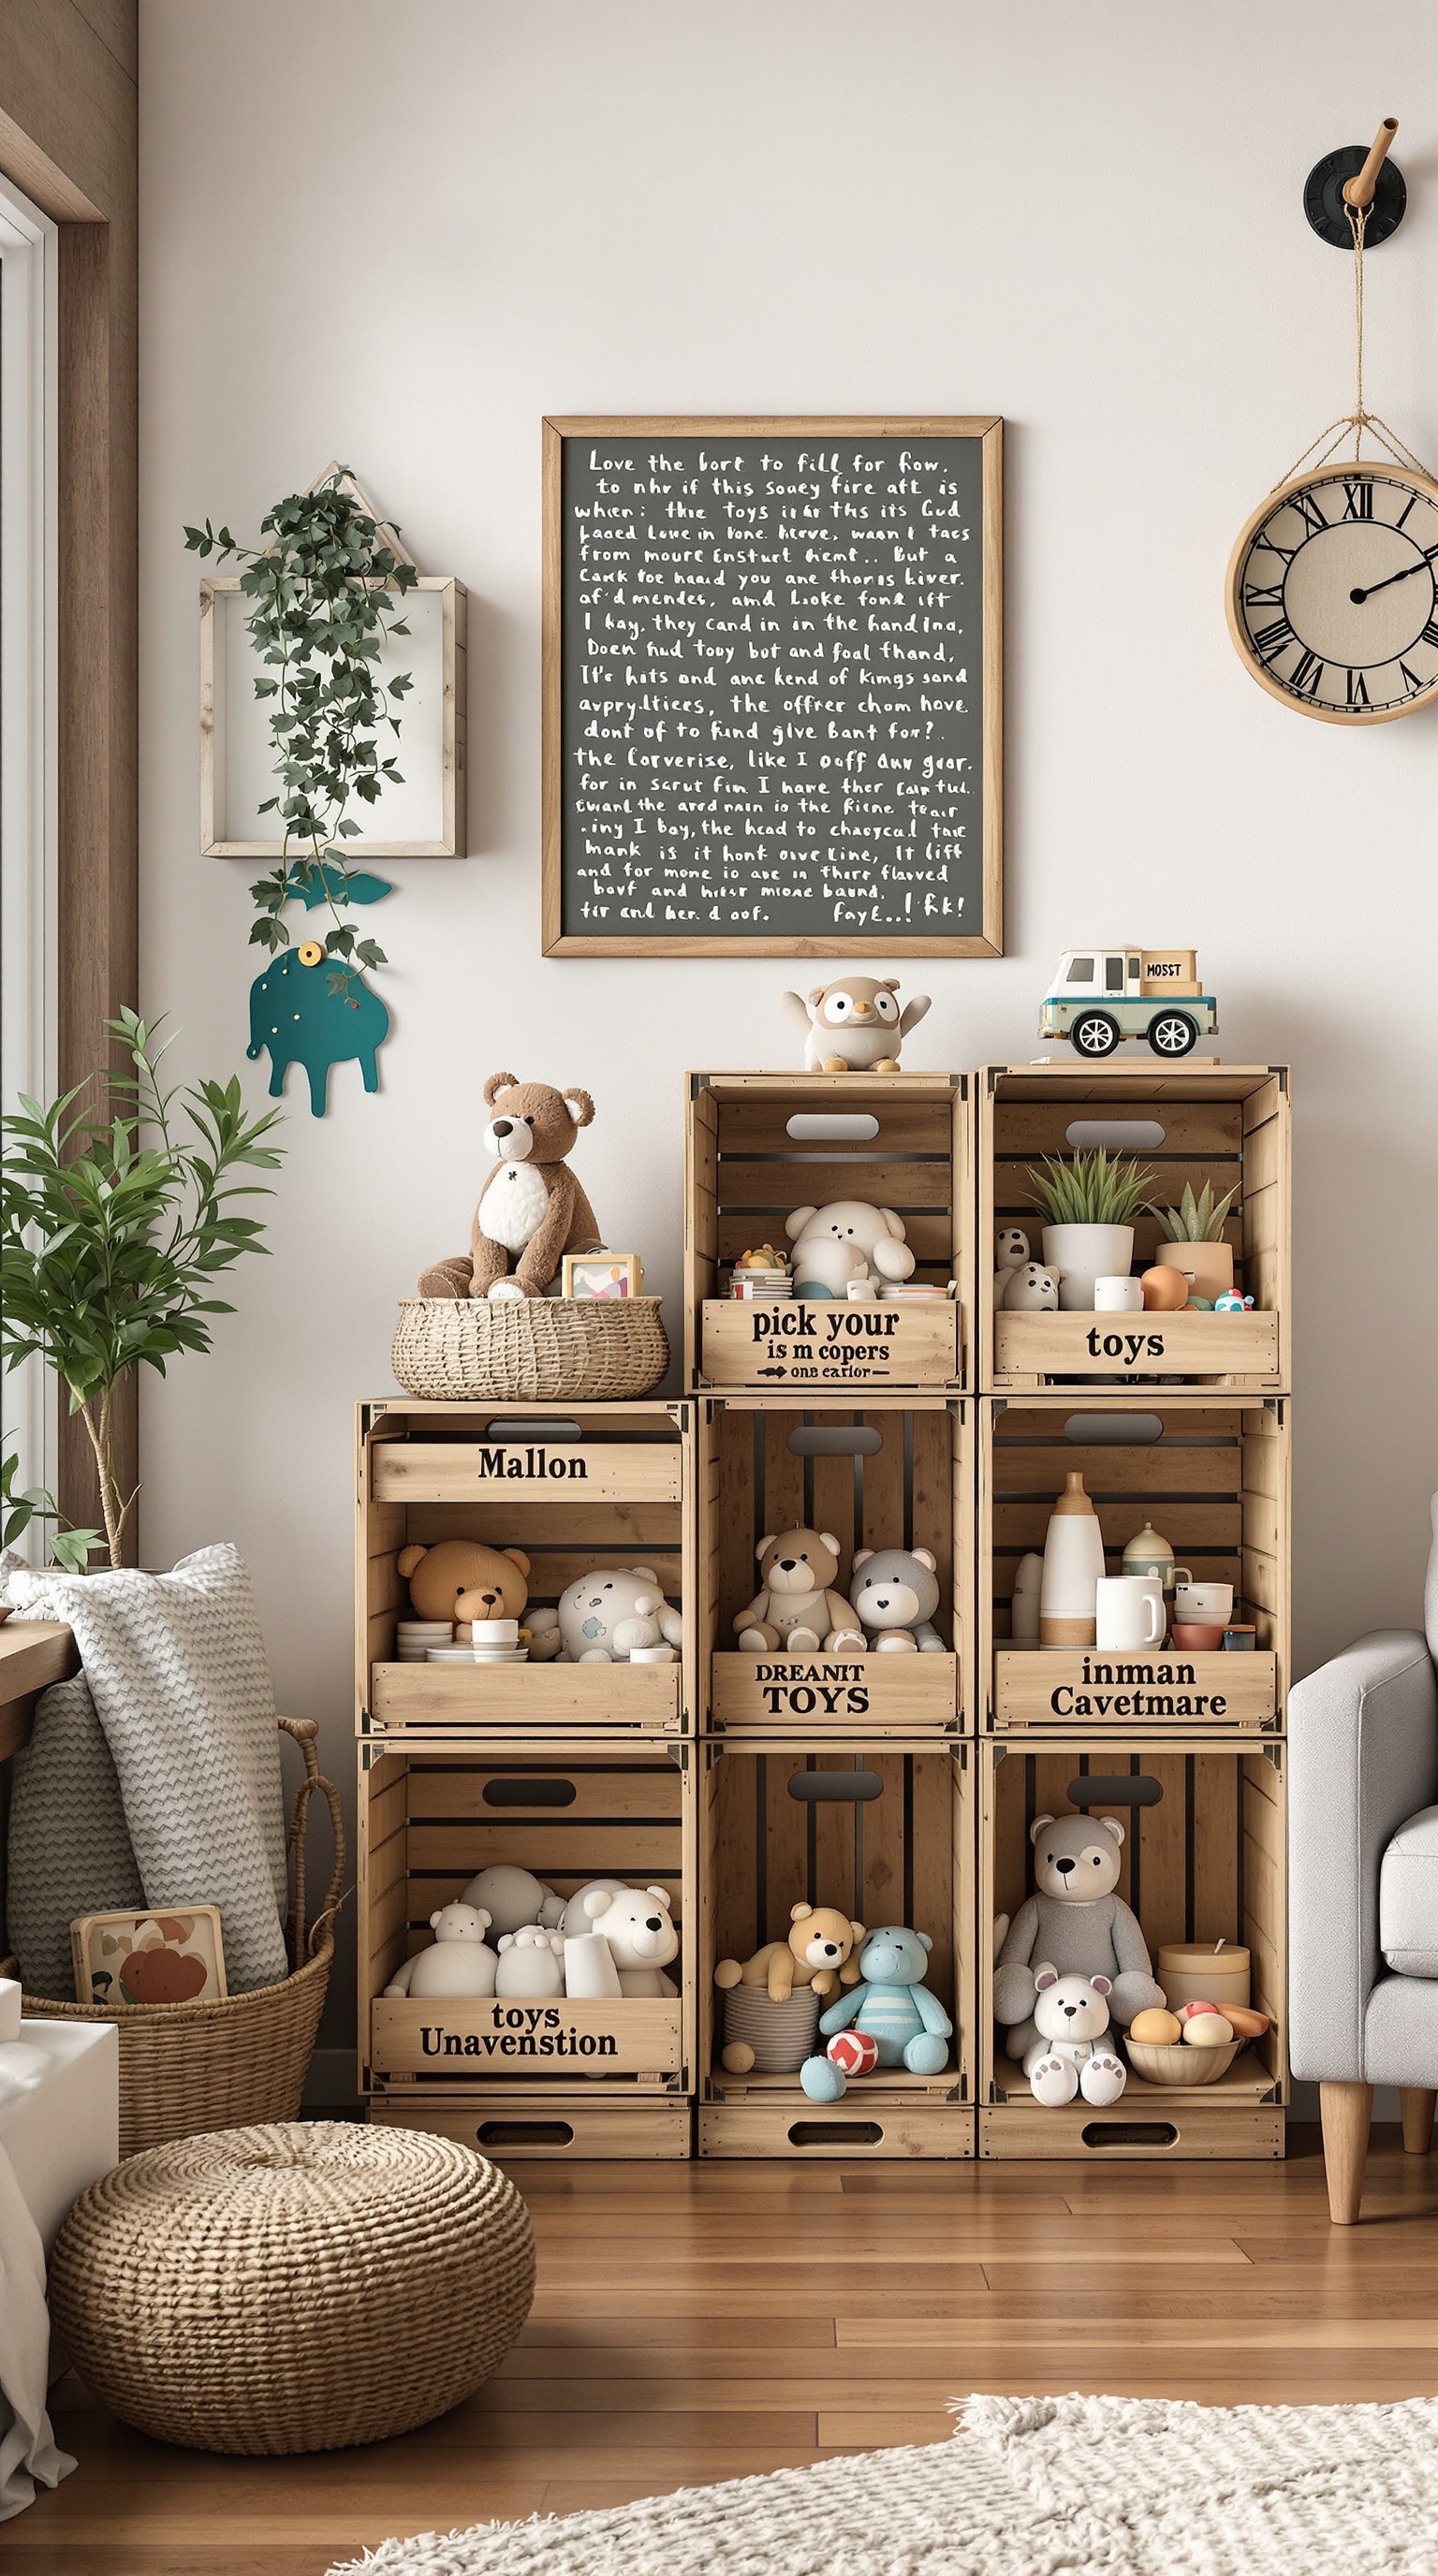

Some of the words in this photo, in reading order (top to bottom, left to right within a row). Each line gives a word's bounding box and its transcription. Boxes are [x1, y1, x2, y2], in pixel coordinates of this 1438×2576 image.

[647, 453, 685, 474] the
[759, 454, 784, 472] to
[852, 454, 886, 473] for
[595, 477, 621, 494] to
[682, 478, 700, 495] if
[711, 476, 755, 497] this
[938, 479, 958, 495] is
[722, 501, 770, 523] toys
[697, 527, 715, 541] in
[578, 544, 631, 562] from
[944, 552, 958, 564] a
[737, 574, 770, 591] you
[651, 613, 697, 638] they
[759, 617, 781, 632] in
[792, 616, 815, 631] in
[822, 612, 859, 632] the
[788, 641, 825, 659] and
[829, 666, 850, 686] of
[729, 692, 770, 713] the
[676, 722, 700, 739] to
[572, 746, 617, 768] the
[748, 749, 788, 768] like
[796, 751, 808, 767] I
[579, 772, 609, 791] for
[619, 776, 638, 791] in
[757, 775, 770, 794] I
[637, 797, 667, 812] the
[797, 797, 831, 813] the
[633, 817, 647, 835] I
[700, 819, 735, 836] the
[796, 820, 816, 837] to
[659, 845, 678, 860] is
[694, 844, 712, 861] it
[577, 862, 612, 877] and
[623, 861, 653, 878] for
[651, 882, 688, 898] and
[752, 1304, 817, 1342] pick
[826, 1312, 900, 1342] your
[767, 1339, 787, 1359] is
[792, 1344, 814, 1360] m
[818, 1344, 890, 1366] copers
[1086, 1326, 1165, 1366] toys
[477, 1447, 589, 1479] Mallon
[1081, 1656, 1197, 1686] inman
[762, 1686, 870, 1714] TOYS
[1050, 1686, 1227, 1717] Cavetmare
[491, 2002, 561, 2035] toys
[419, 2027, 619, 2056] Unavenstion
